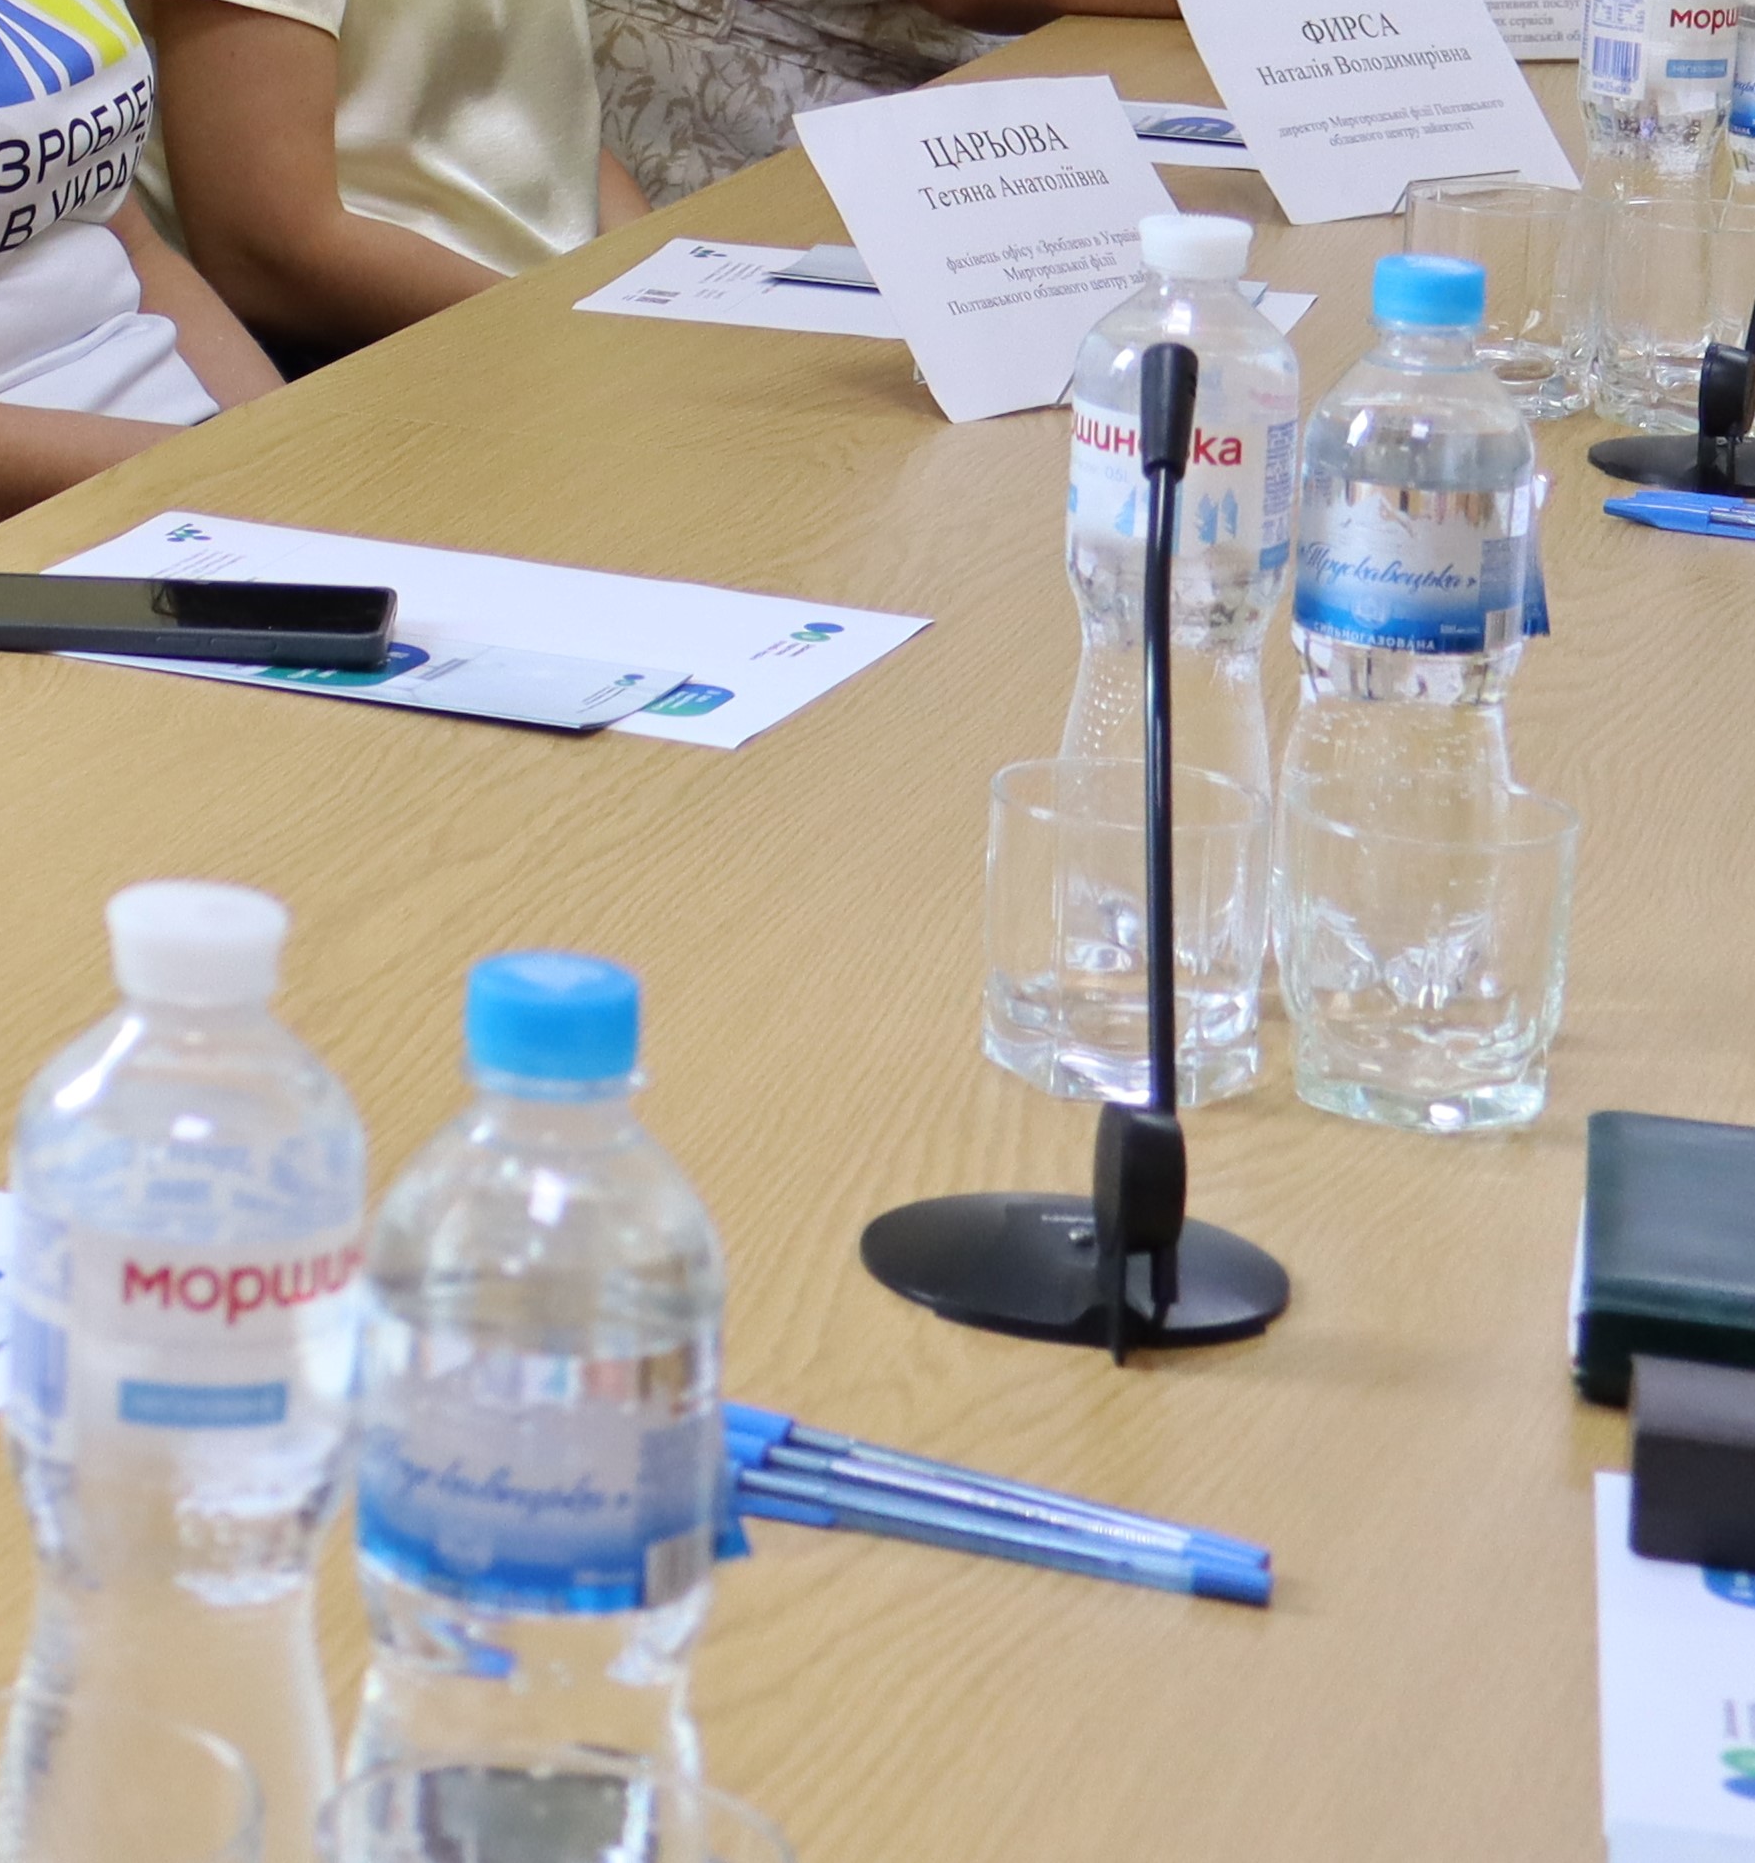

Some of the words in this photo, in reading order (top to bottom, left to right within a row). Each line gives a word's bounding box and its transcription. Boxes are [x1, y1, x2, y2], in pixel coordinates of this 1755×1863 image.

[1301, 12, 1400, 44] ФИРСА
[1669, 7, 1740, 35] морш
[1256, 58, 1334, 86] Наталія
[1333, 45, 1472, 75] Володимирівна
[920, 122, 1069, 170] ЦАРЬОВА
[52, 132, 146, 222] УКРАЇ
[918, 182, 997, 210] Тетяна
[999, 165, 1109, 197] Анатоліївна
[946, 252, 1001, 274] фахівець
[1002, 243, 1035, 263] офісу
[1003, 257, 1089, 282] Миргородської
[1090, 252, 1117, 272] філії
[946, 288, 1032, 316] Полтавського
[1033, 283, 1089, 300] обласного
[1090, 274, 1127, 291] центру
